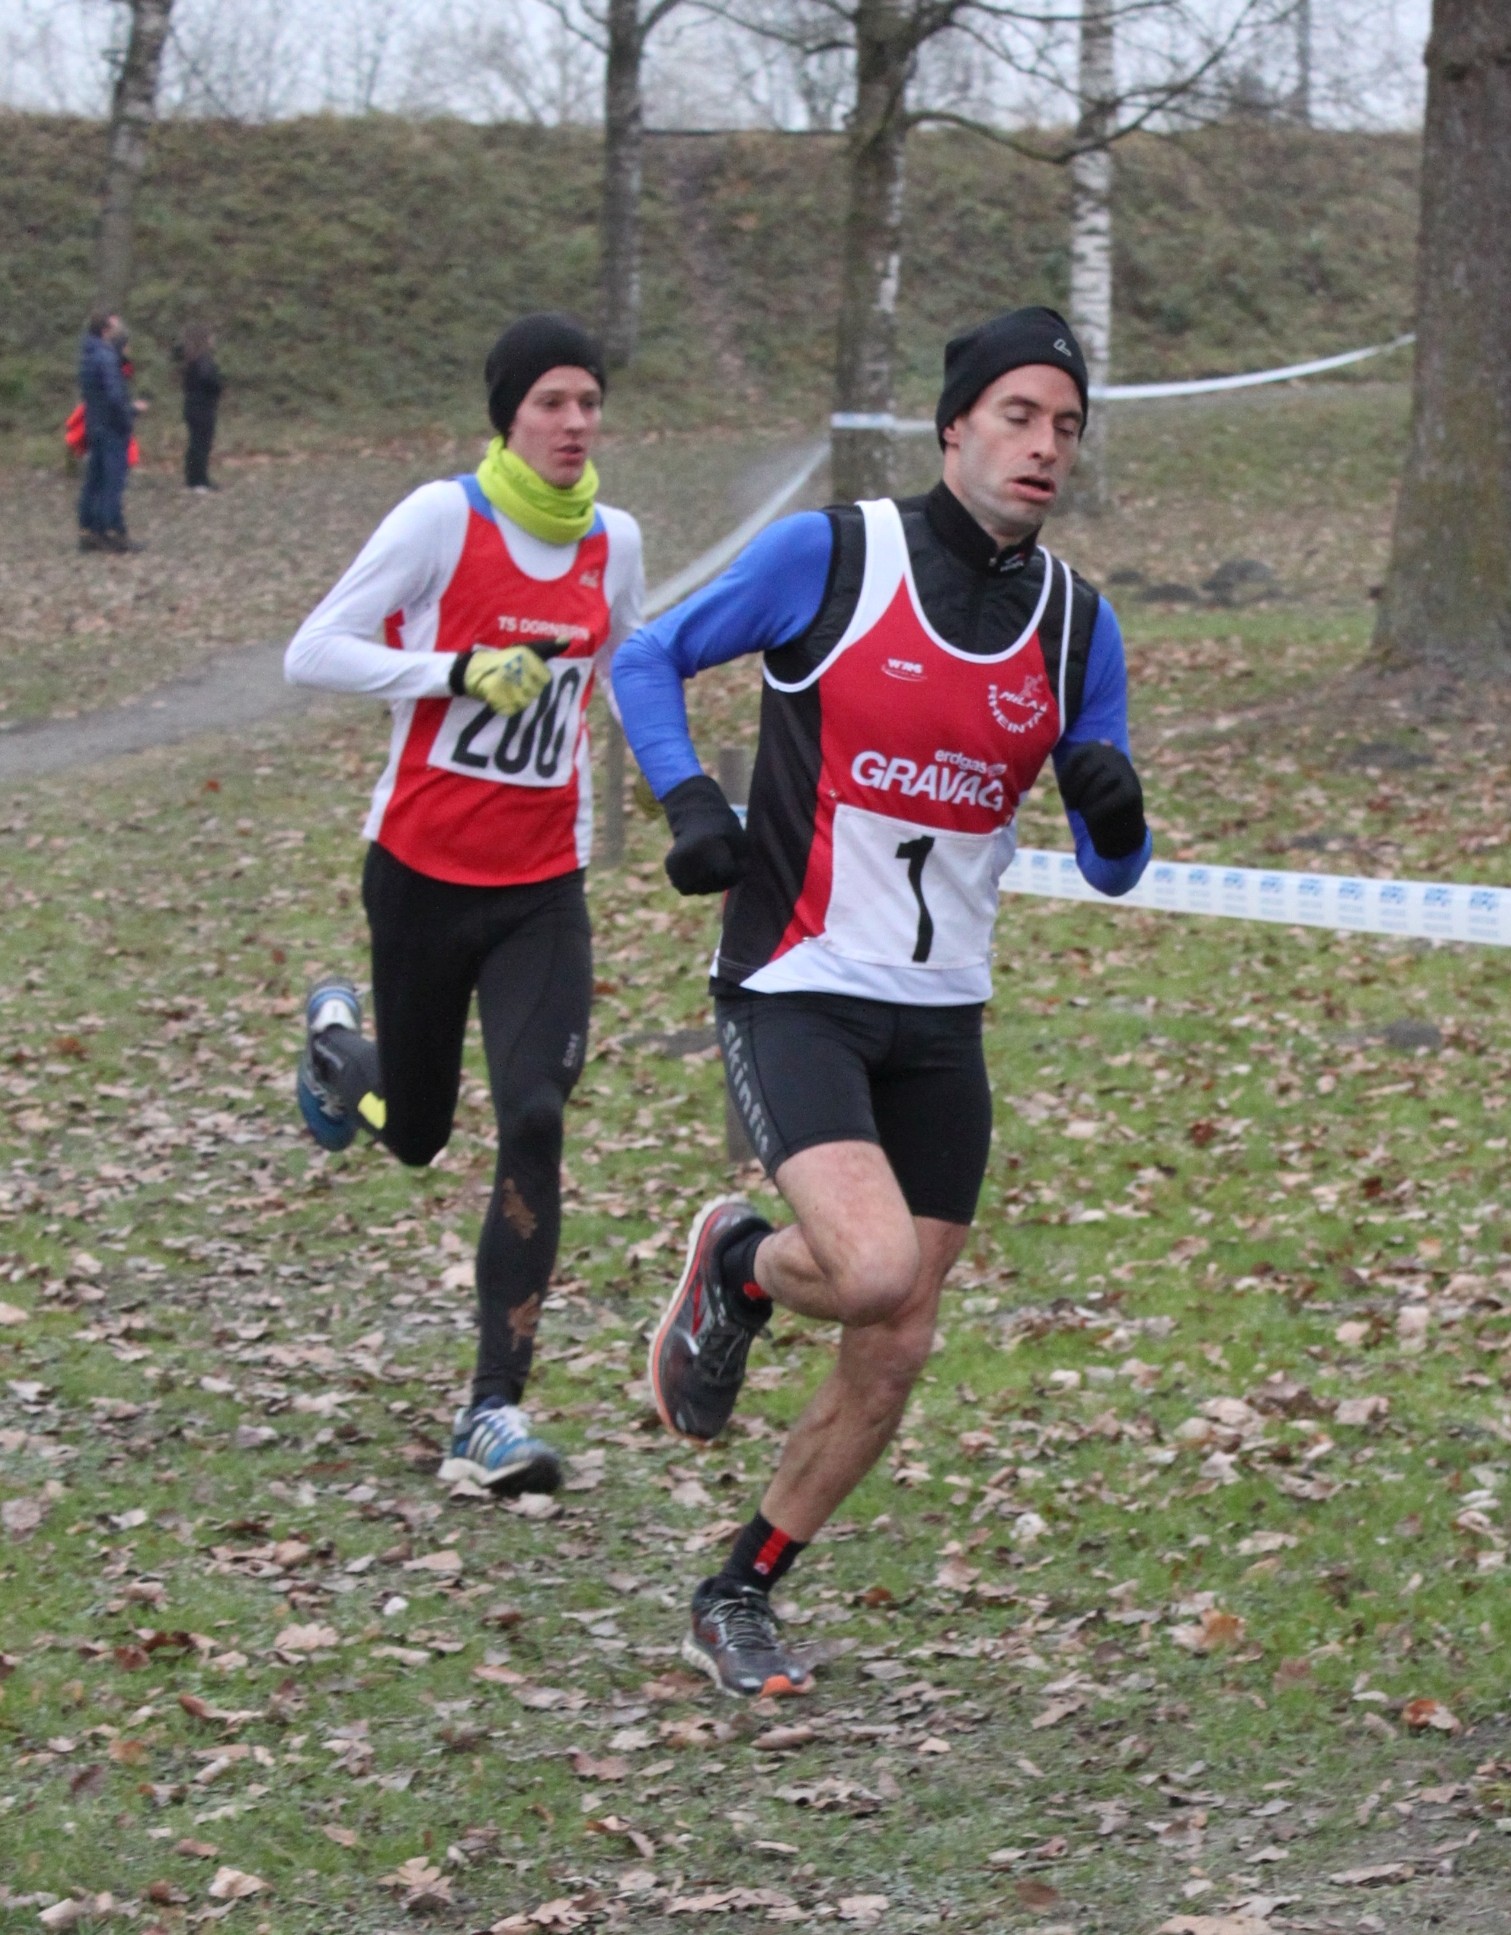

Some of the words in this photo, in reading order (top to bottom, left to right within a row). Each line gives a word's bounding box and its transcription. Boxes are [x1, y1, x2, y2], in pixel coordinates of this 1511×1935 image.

[498, 616, 517, 632] TS
[451, 666, 581, 779] 200
[851, 750, 1005, 812] GRAVAG
[934, 748, 988, 774] erdgas
[895, 835, 935, 963] 1
